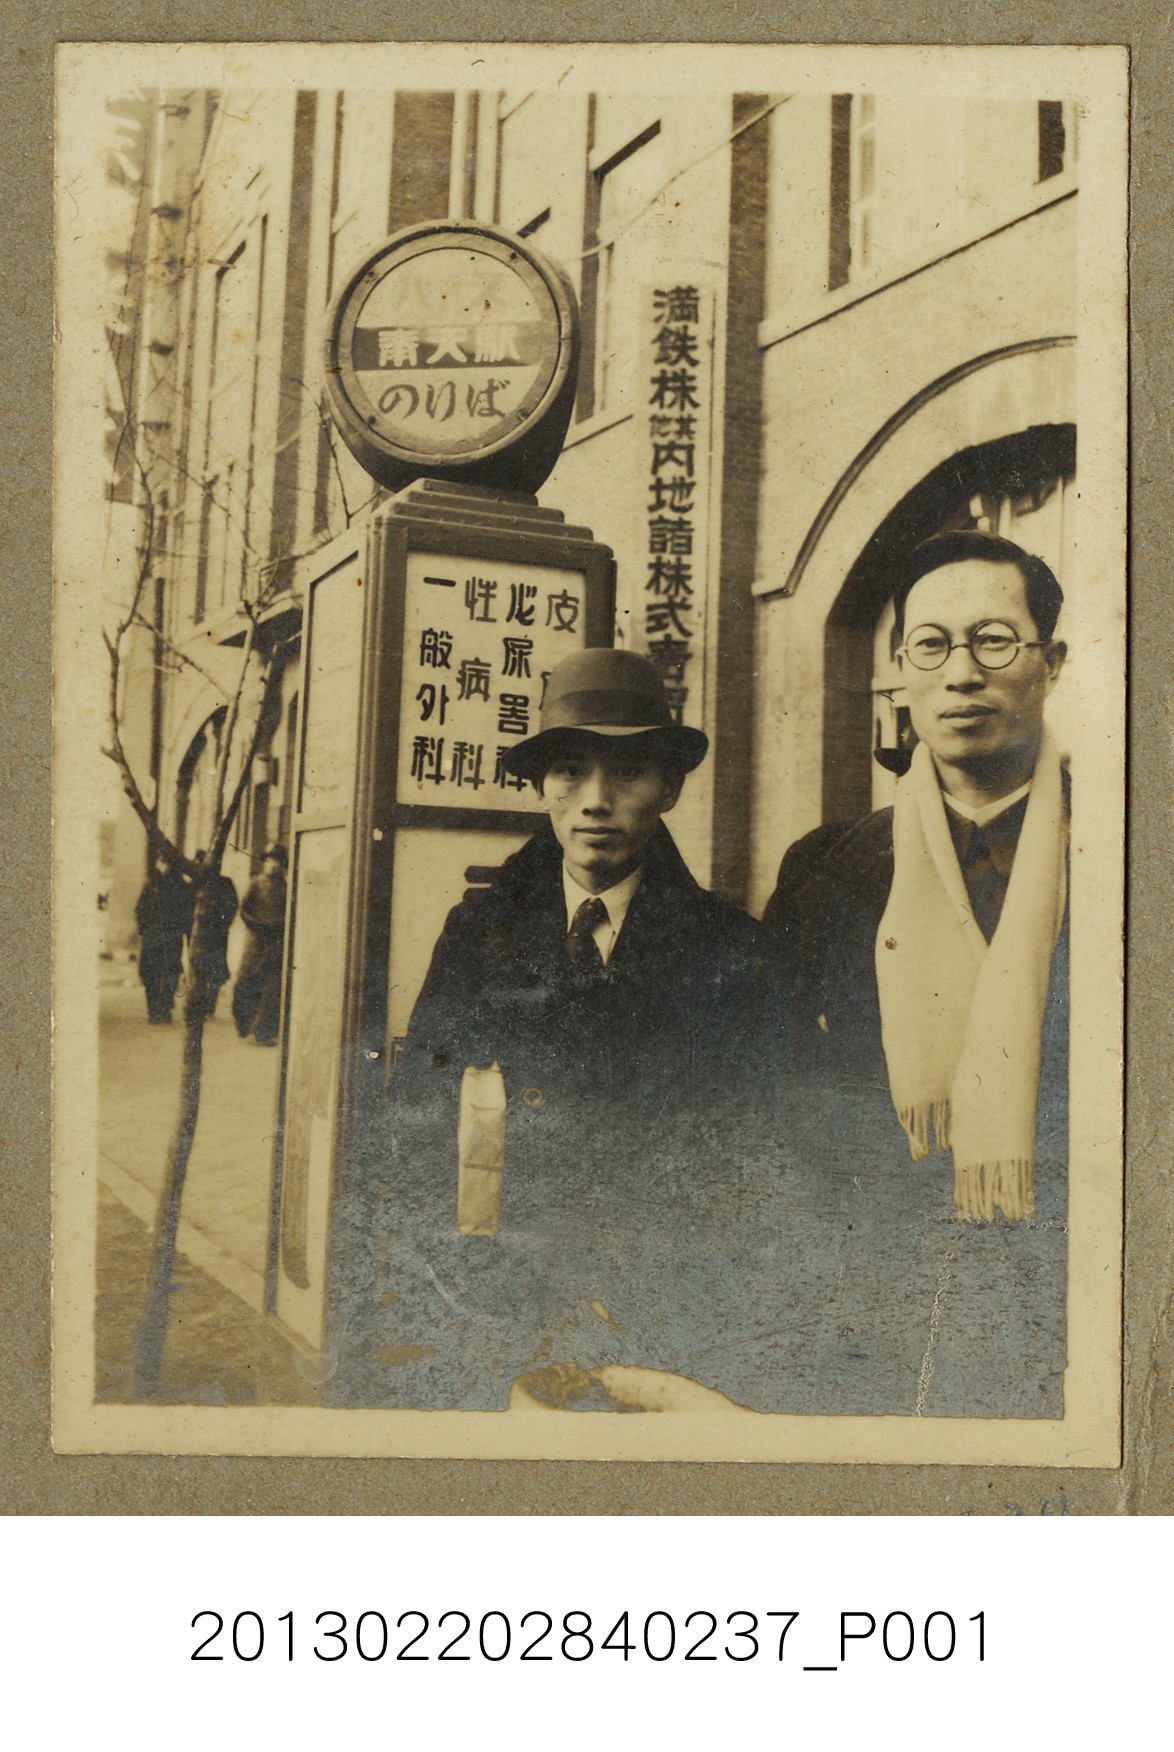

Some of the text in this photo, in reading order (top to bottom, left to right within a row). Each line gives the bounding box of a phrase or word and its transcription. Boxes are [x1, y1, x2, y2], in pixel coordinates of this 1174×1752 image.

[378, 378, 511, 422] のりば
[411, 577, 456, 785] 一般外科
[450, 576, 498, 791] 性病科
